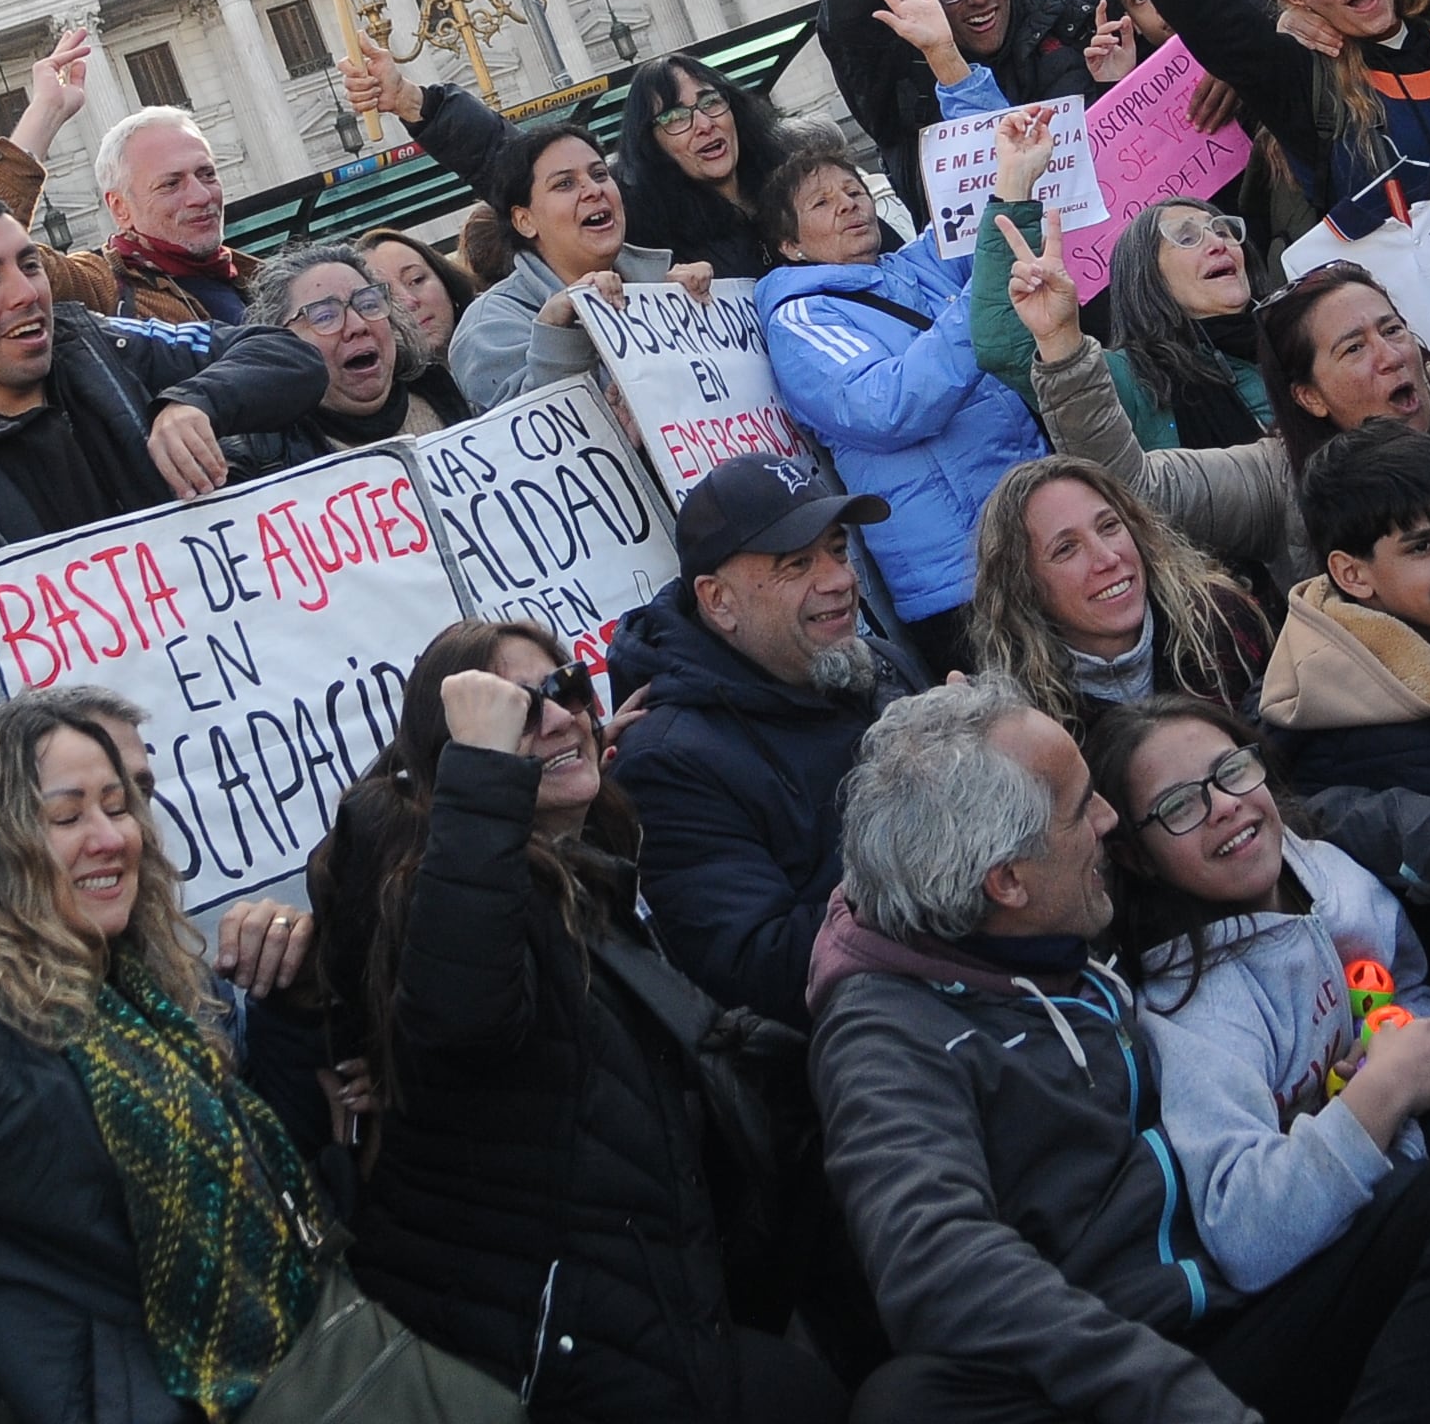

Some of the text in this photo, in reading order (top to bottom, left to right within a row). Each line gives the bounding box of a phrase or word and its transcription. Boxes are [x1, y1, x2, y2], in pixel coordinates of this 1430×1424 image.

[519, 102, 539, 118] del
[1117, 76, 1201, 182] SE VET
[397, 146, 415, 160] 60
[689, 357, 730, 404] EN
[510, 396, 591, 462] CON
[179, 519, 262, 613] DE
[256, 477, 429, 611] AJUSTES
[164, 619, 262, 712] EN
